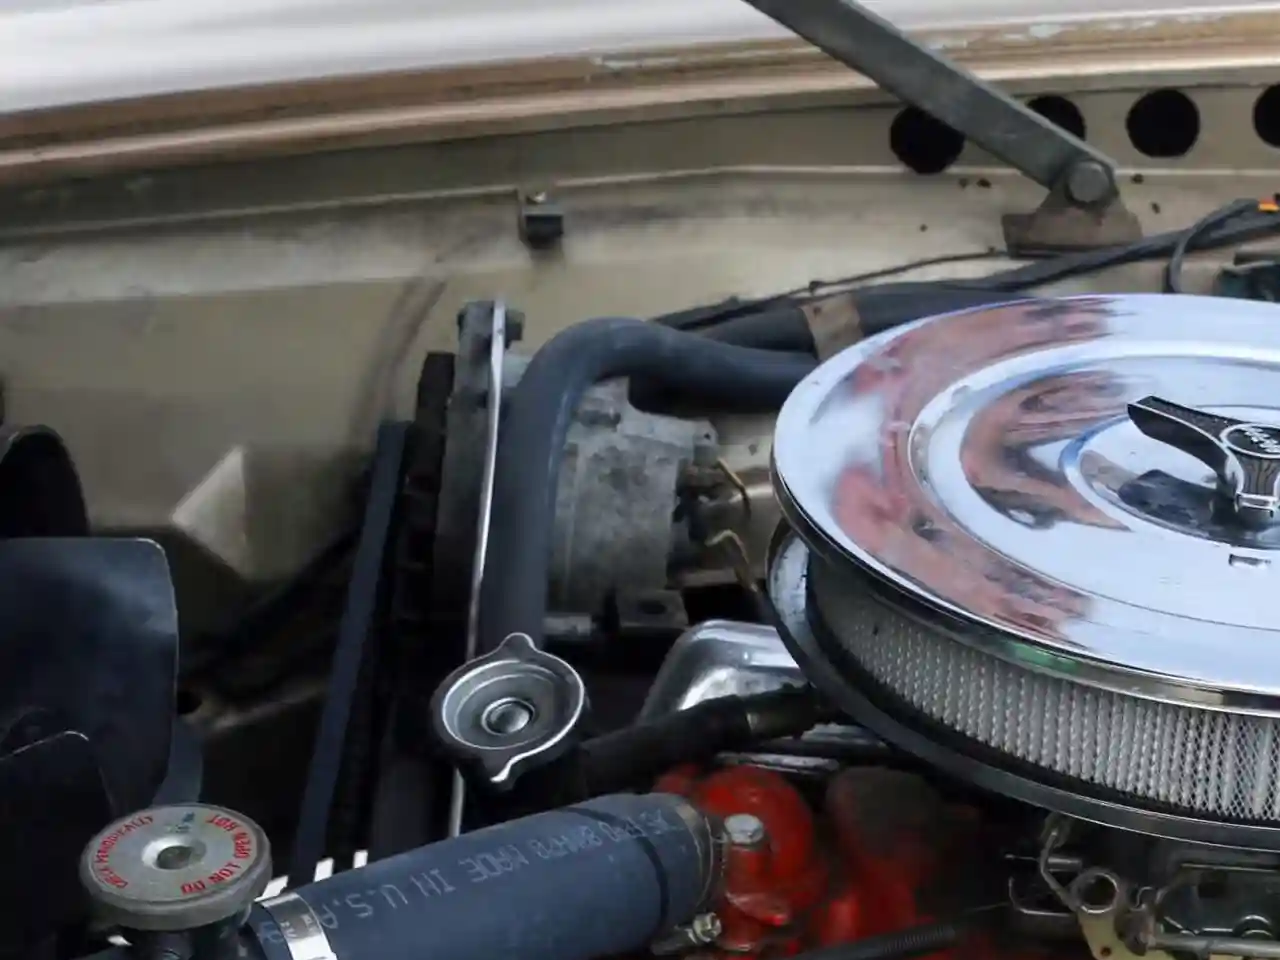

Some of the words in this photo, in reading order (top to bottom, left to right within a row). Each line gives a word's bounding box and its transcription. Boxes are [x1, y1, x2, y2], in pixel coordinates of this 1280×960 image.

[207, 814, 238, 832] HOT
[233, 832, 251, 860] OPEN
[208, 862, 241, 885] NOT
[459, 844, 530, 882] MADE
[181, 880, 206, 894] DO
[410, 869, 456, 897] IN
